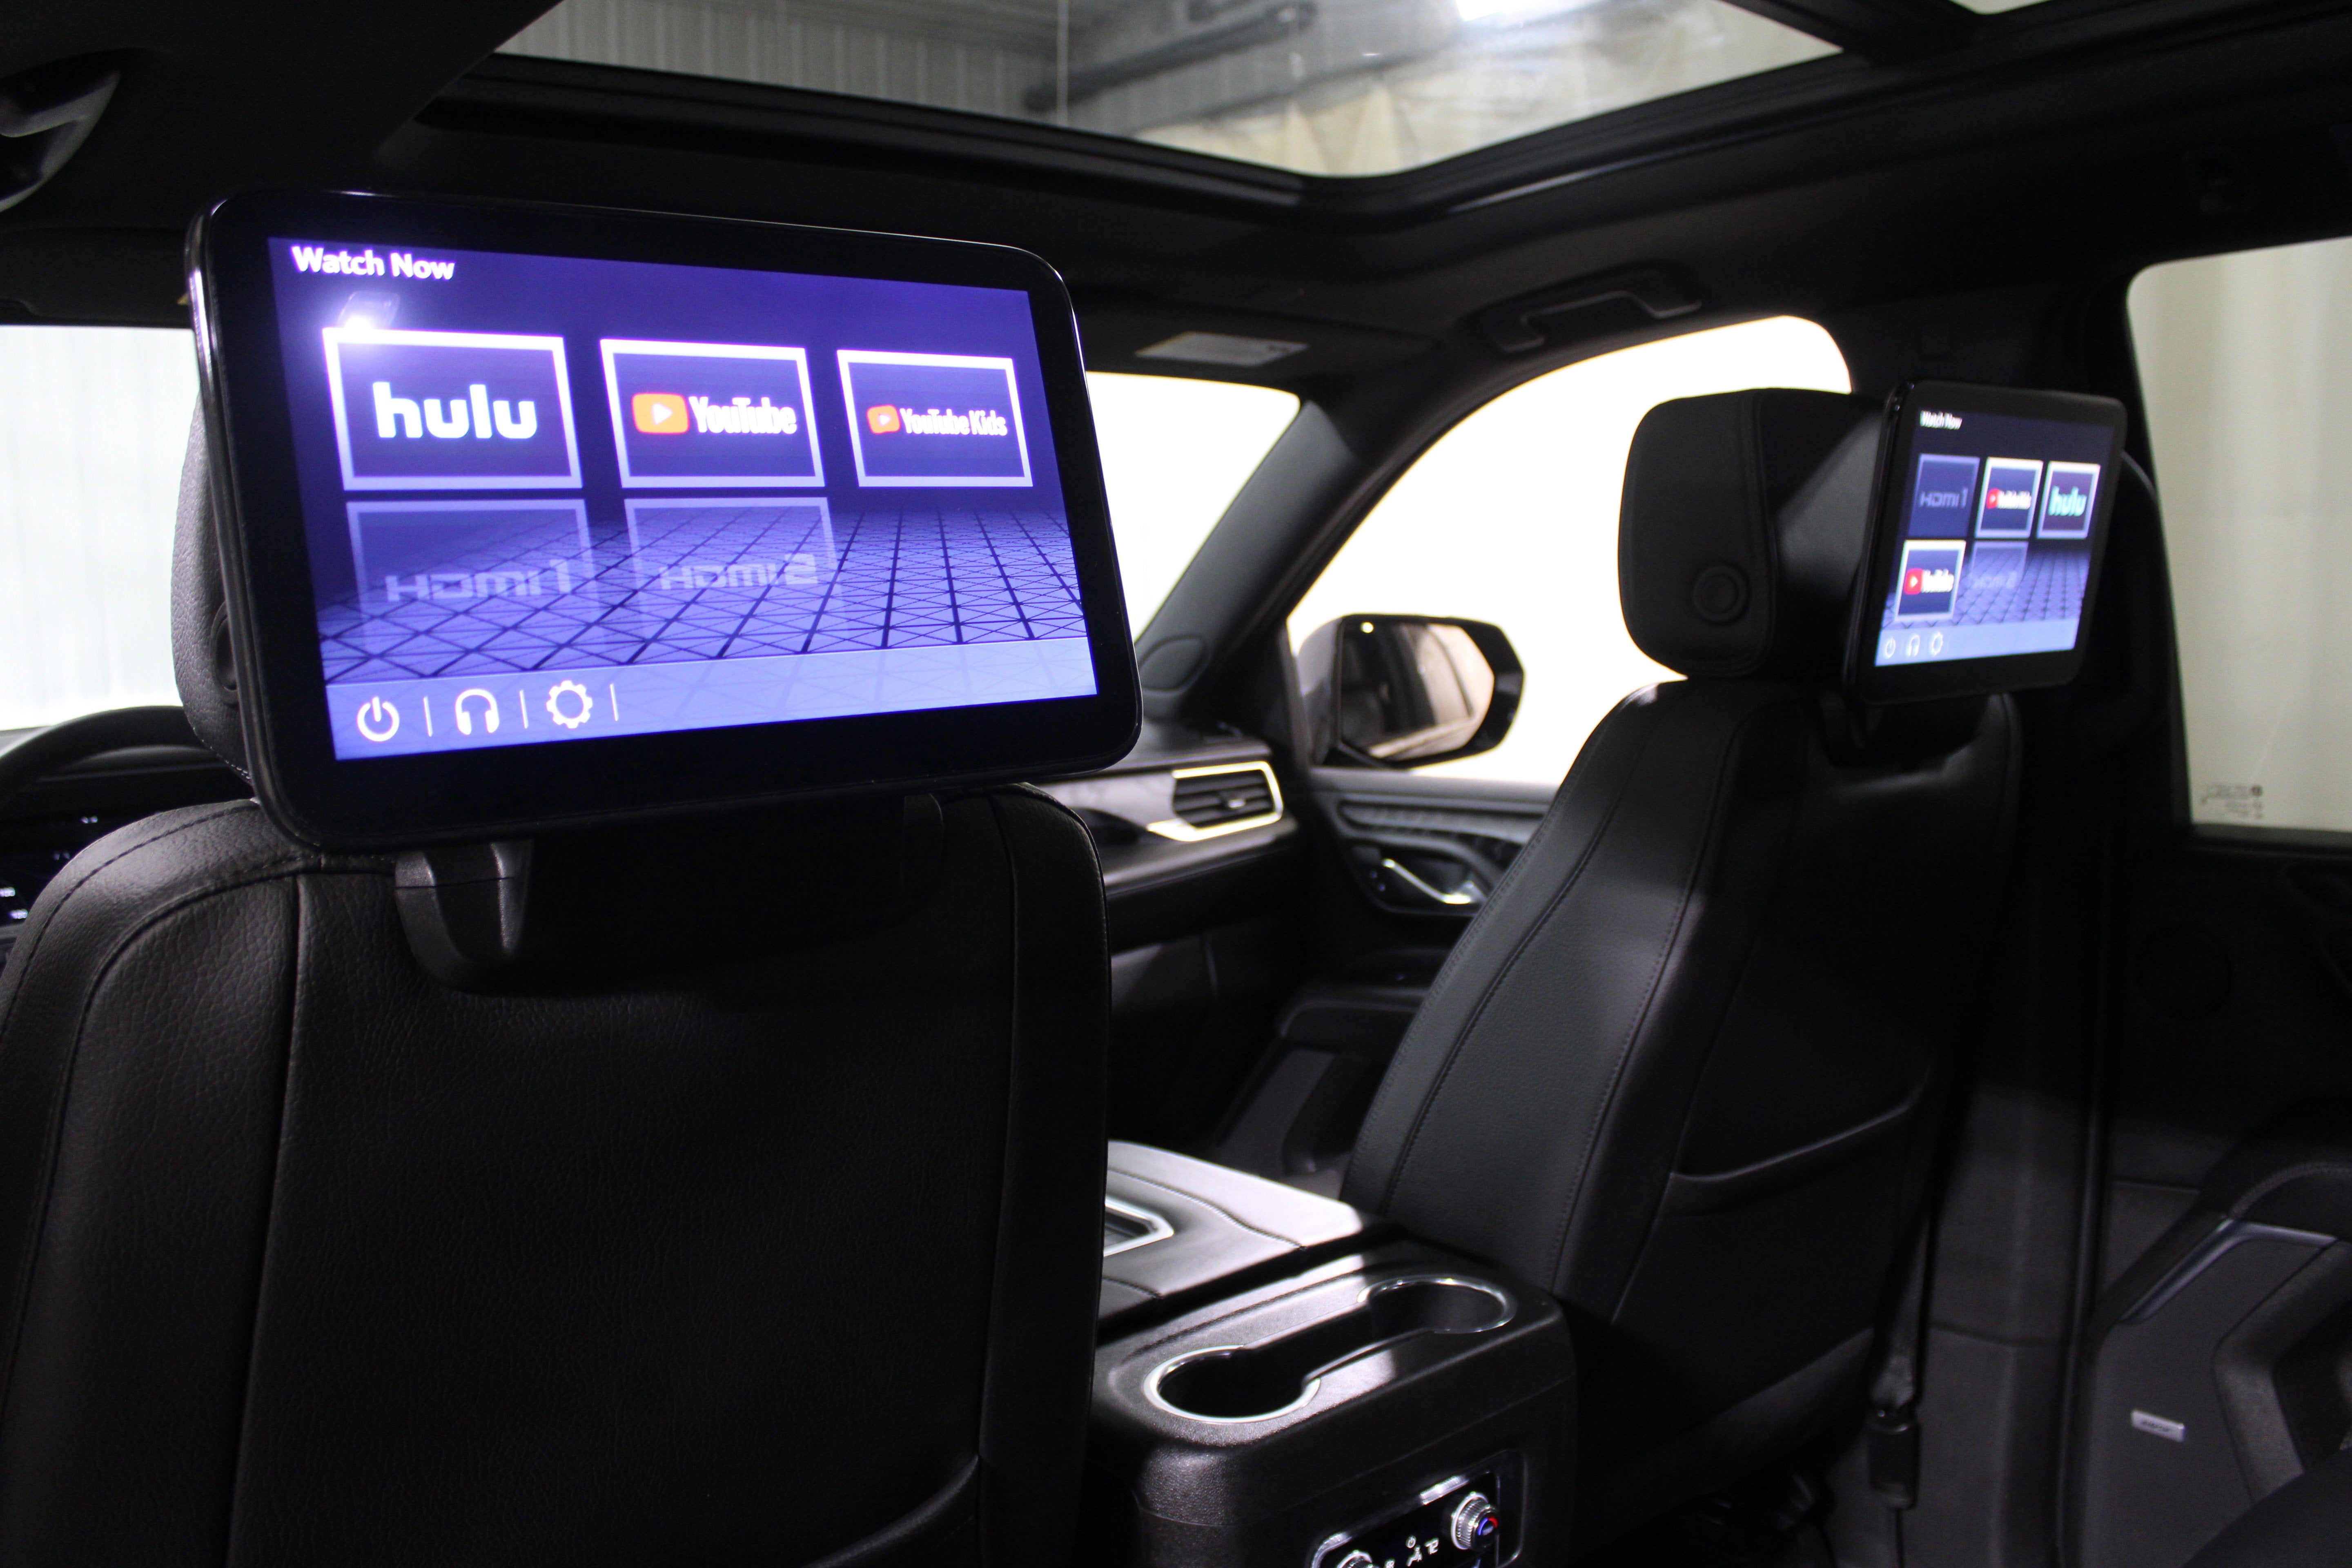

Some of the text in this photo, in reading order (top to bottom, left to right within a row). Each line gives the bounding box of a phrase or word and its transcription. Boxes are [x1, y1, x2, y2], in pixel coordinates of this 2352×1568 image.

[291, 246, 455, 280] Watch Now
[372, 381, 537, 439] hulu
[688, 396, 797, 434] YouTube
[900, 408, 1008, 436] YouTube Kids
[1920, 410, 1962, 430] Watch Now
[2048, 486, 2087, 517] hulu
[549, 559, 571, 595] 1
[784, 553, 818, 586] 2
